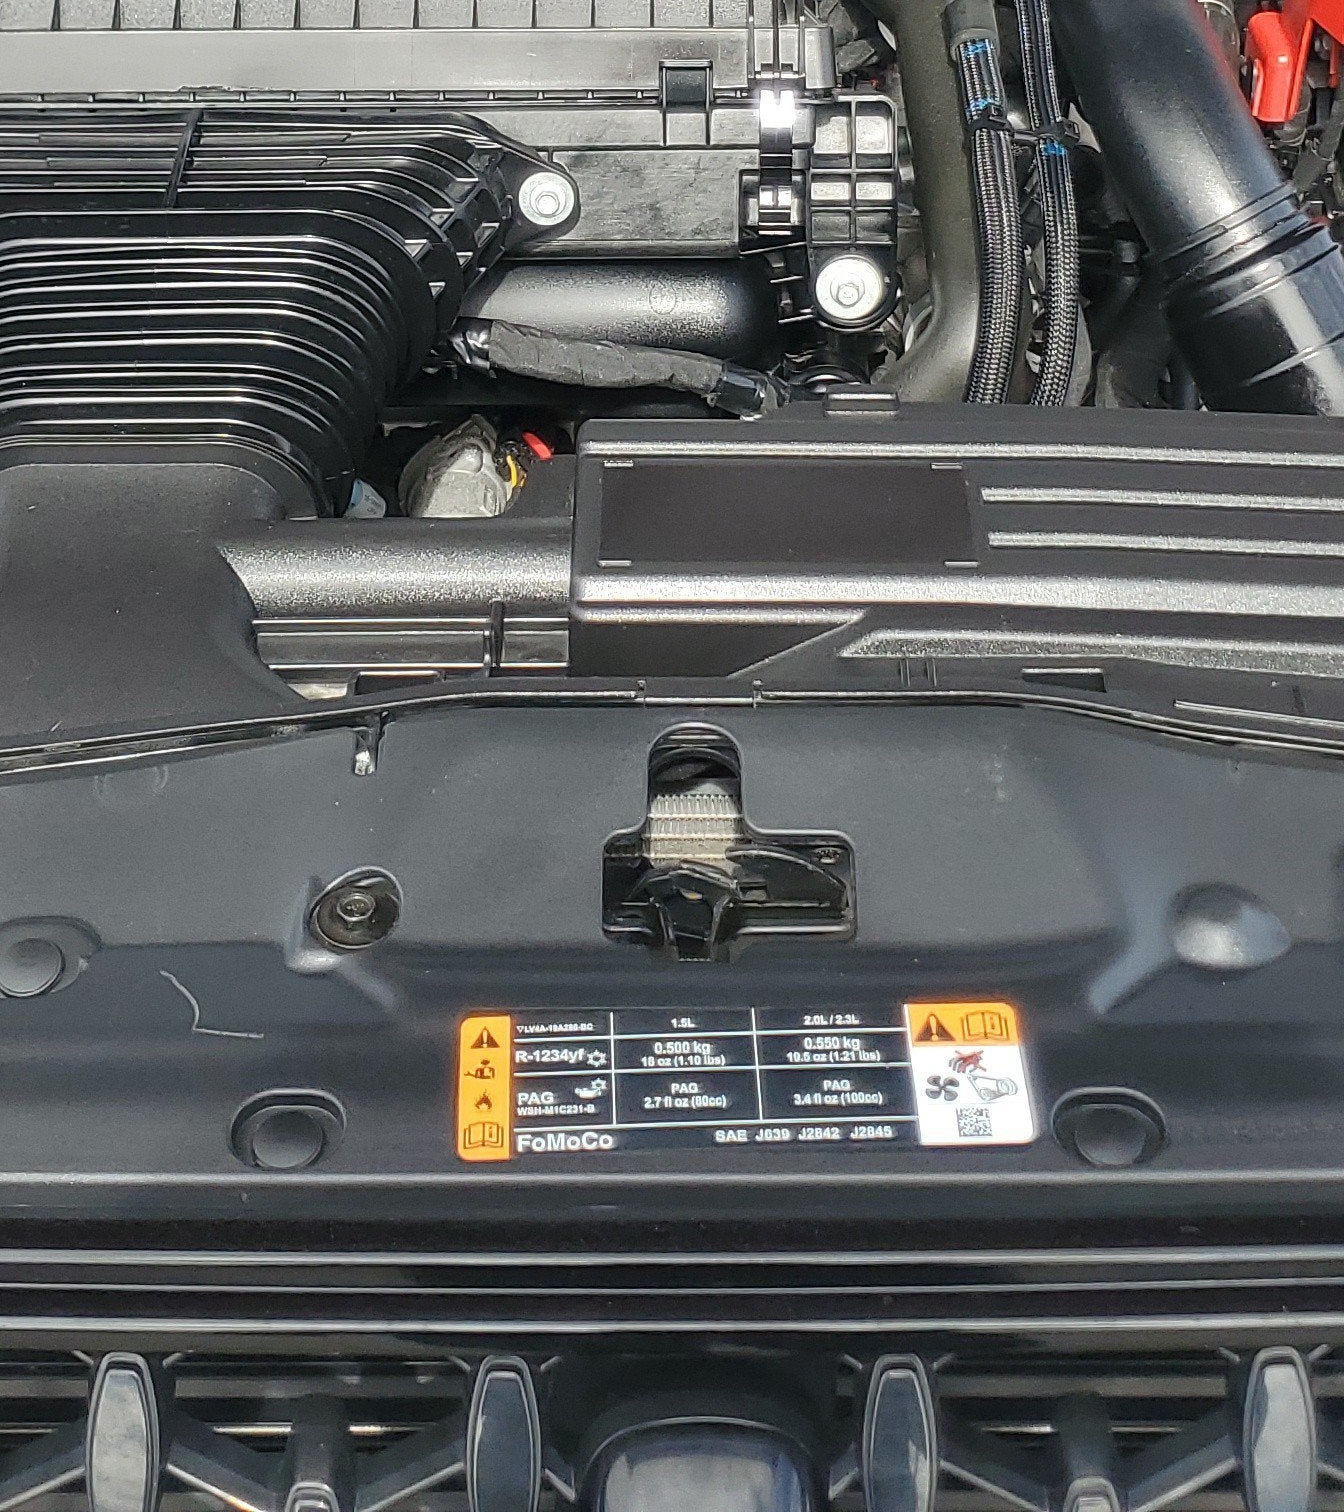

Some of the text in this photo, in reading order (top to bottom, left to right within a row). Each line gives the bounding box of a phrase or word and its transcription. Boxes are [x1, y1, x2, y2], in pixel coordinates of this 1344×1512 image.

[671, 1017, 696, 1028] 1.5L
[803, 1015, 829, 1025] 2.0L
[835, 1014, 860, 1025] 2.3L
[654, 1041, 711, 1055] 0.500 kg
[803, 1036, 861, 1051] 0.550 kg
[516, 1049, 585, 1064] R-1234yf
[657, 1057, 672, 1066] oz
[674, 1055, 702, 1067] (1.10
[703, 1054, 726, 1066] lbs)
[812, 1053, 827, 1062] oz
[829, 1051, 857, 1062] (1.21
[859, 1050, 881, 1062] lbs)
[671, 1082, 699, 1094] PAG
[823, 1079, 851, 1091] PAG
[518, 1091, 554, 1106] PAG
[644, 1094, 727, 1109] 2.7 fl oz (80cc)
[793, 1091, 883, 1105] 3.4 fl oz (100cc)
[715, 1126, 893, 1143] SAE J639 J2842 J2845
[517, 1131, 614, 1153] FoMoCo
